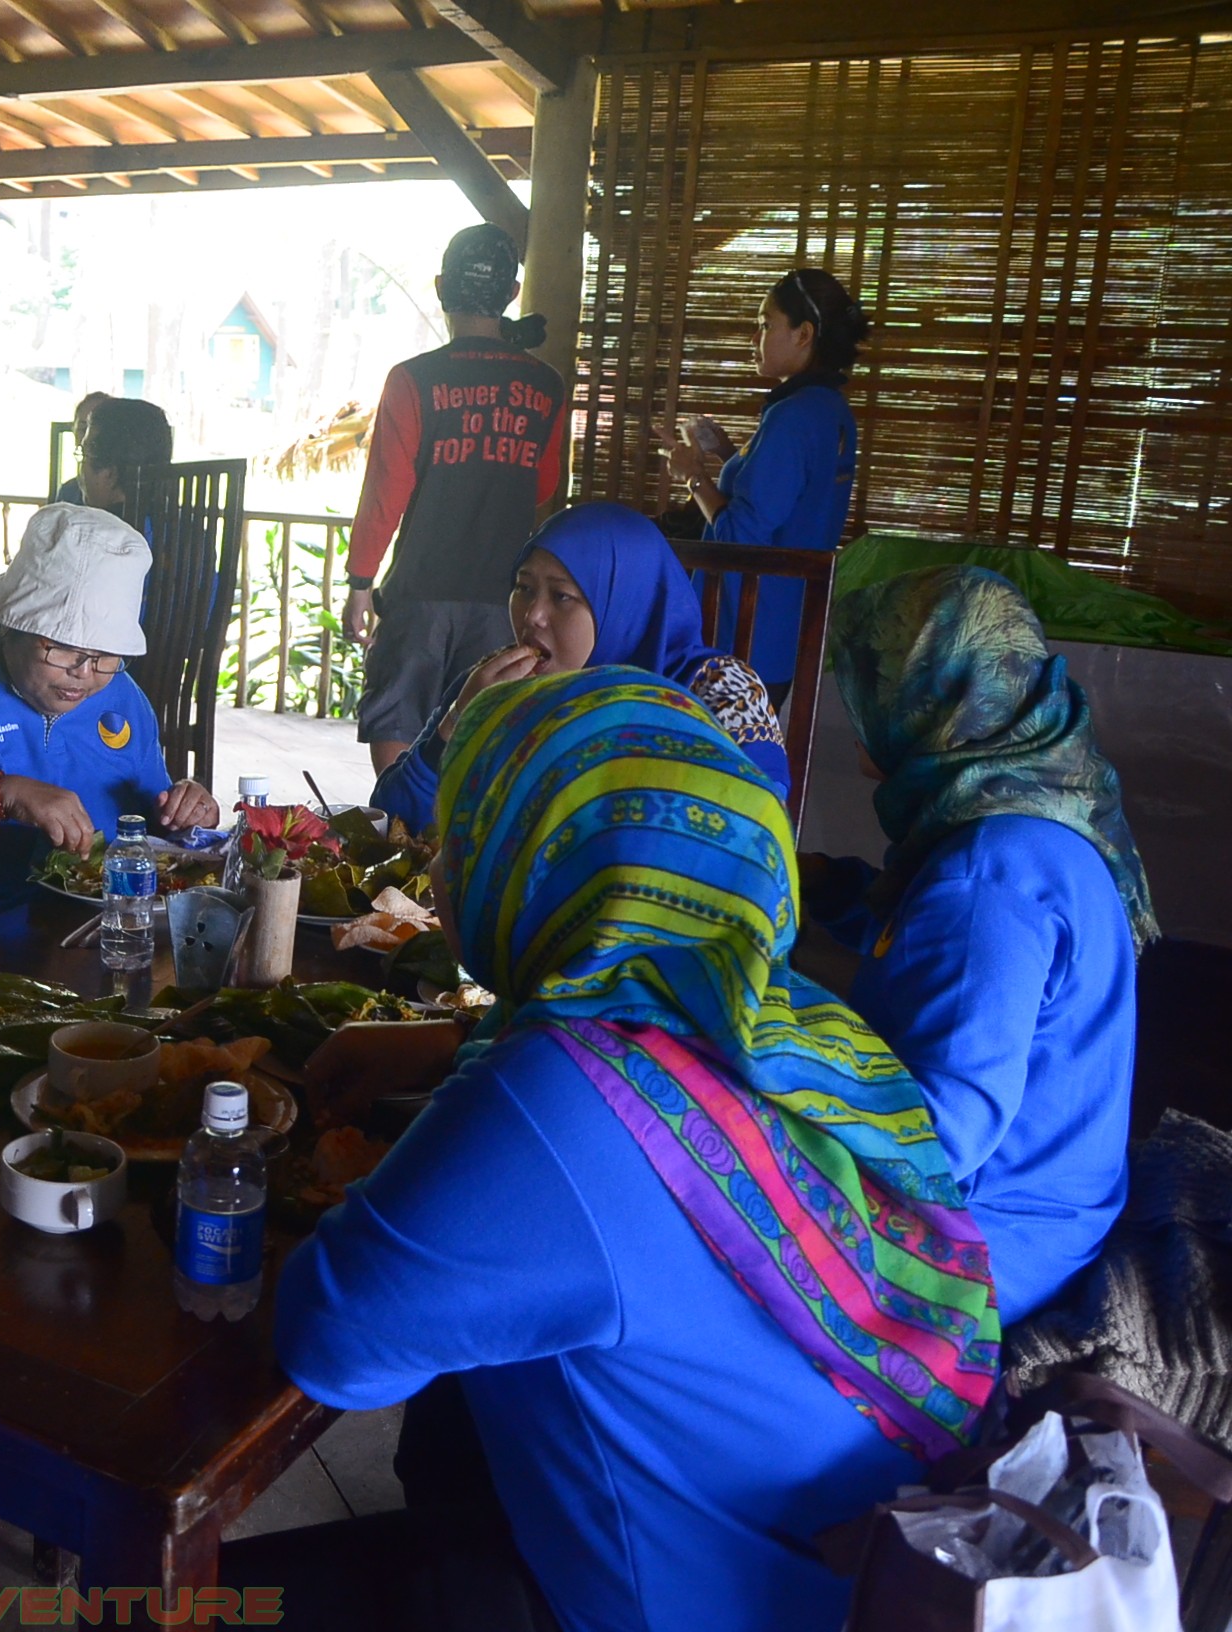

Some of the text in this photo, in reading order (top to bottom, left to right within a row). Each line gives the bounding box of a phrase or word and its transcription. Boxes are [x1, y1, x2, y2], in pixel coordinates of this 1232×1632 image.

[432, 383, 500, 411] Never
[462, 407, 528, 435] to the
[483, 436, 538, 468] LEVE
